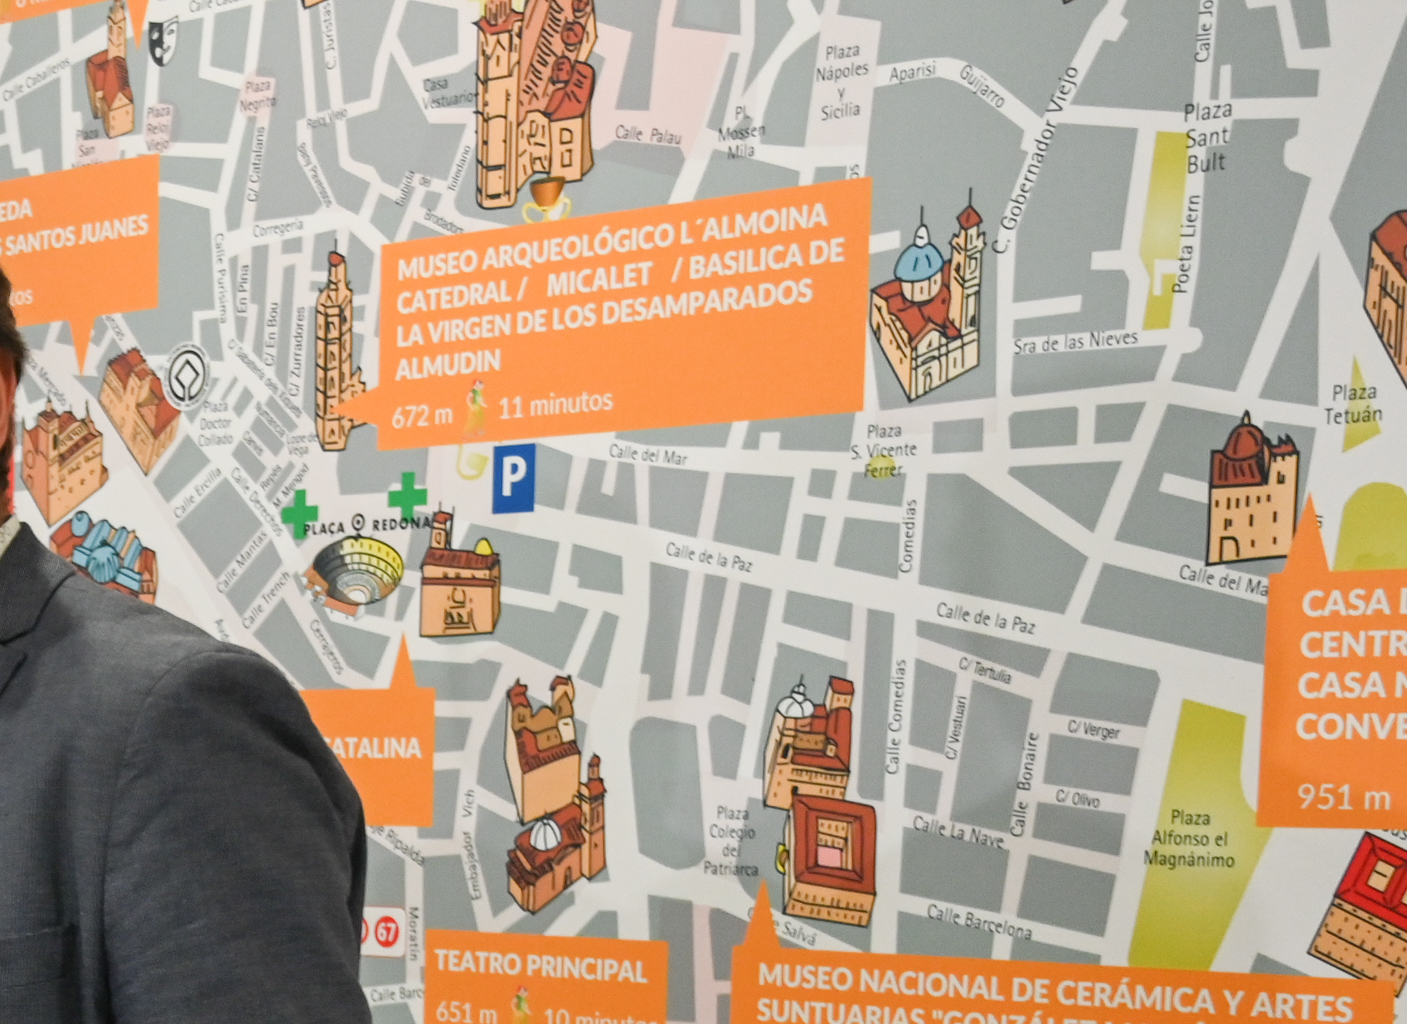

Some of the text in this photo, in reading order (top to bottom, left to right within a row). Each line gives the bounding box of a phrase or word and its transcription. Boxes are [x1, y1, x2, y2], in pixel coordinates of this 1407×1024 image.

[826, 44, 860, 61] Plaza
[816, 62, 870, 83] Nápoles
[837, 88, 846, 102] y
[889, 60, 1005, 109] Aparisi Guijarro
[820, 103, 861, 122] Sicilia
[1184, 102, 1233, 122] Plaza
[1000, 119, 1057, 231] Gobernador
[1045, 65, 1079, 114] Viejo
[1185, 126, 1230, 149] Sant
[1187, 153, 1226, 174] Bult
[5, 214, 150, 257] SANTOS JUANES
[1172, 194, 1201, 294] Poeta Liern
[397, 250, 479, 281] MUSEO
[482, 220, 675, 270] ARQUEOLÓGICO
[396, 280, 510, 314] CATEDRAL
[547, 262, 653, 298] MICALET
[689, 242, 804, 280] BASILICA
[810, 237, 846, 266] DE
[1013, 330, 1139, 355] Sra de las Nieves
[395, 349, 502, 381] ALMUDIN
[1332, 384, 1377, 401] Plaza
[1324, 405, 1383, 426] Tetuán
[609, 443, 688, 466] Calle del Mar
[303, 515, 431, 537] PLAÇA REDONA
[936, 602, 1036, 635] Calle de la Paz
[1010, 731, 1040, 838] Calle Bonaire
[1171, 808, 1211, 827] Plaza
[1152, 829, 1228, 847] Alfonso el
[1143, 848, 1235, 871] Magnánimo
[434, 949, 649, 983] TEATRO PRINCIPAL
[758, 962, 1354, 1024] MUSEO NACIONAL DE CERÁMICA Y ARTES
